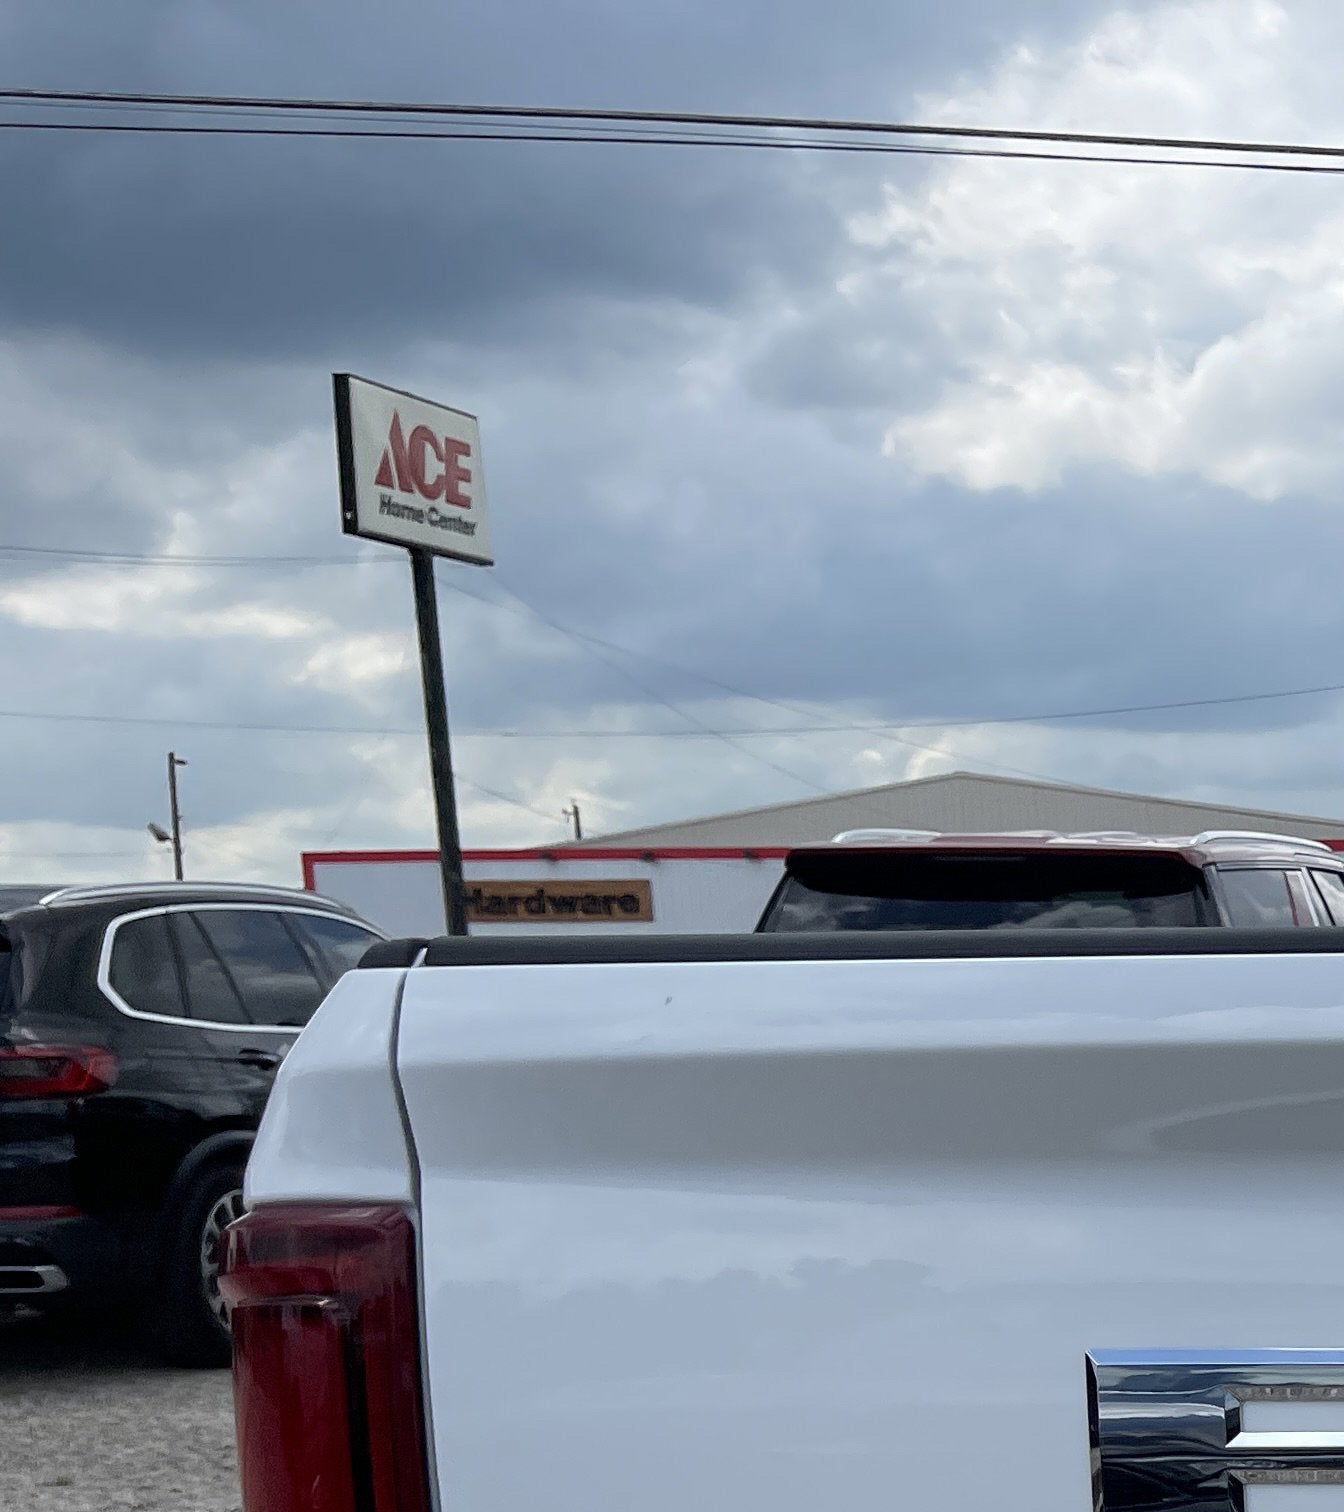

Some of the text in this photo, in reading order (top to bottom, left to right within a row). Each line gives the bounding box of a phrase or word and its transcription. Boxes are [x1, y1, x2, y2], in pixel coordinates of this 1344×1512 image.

[374, 408, 472, 510] ACE
[379, 493, 478, 537] Home Center
